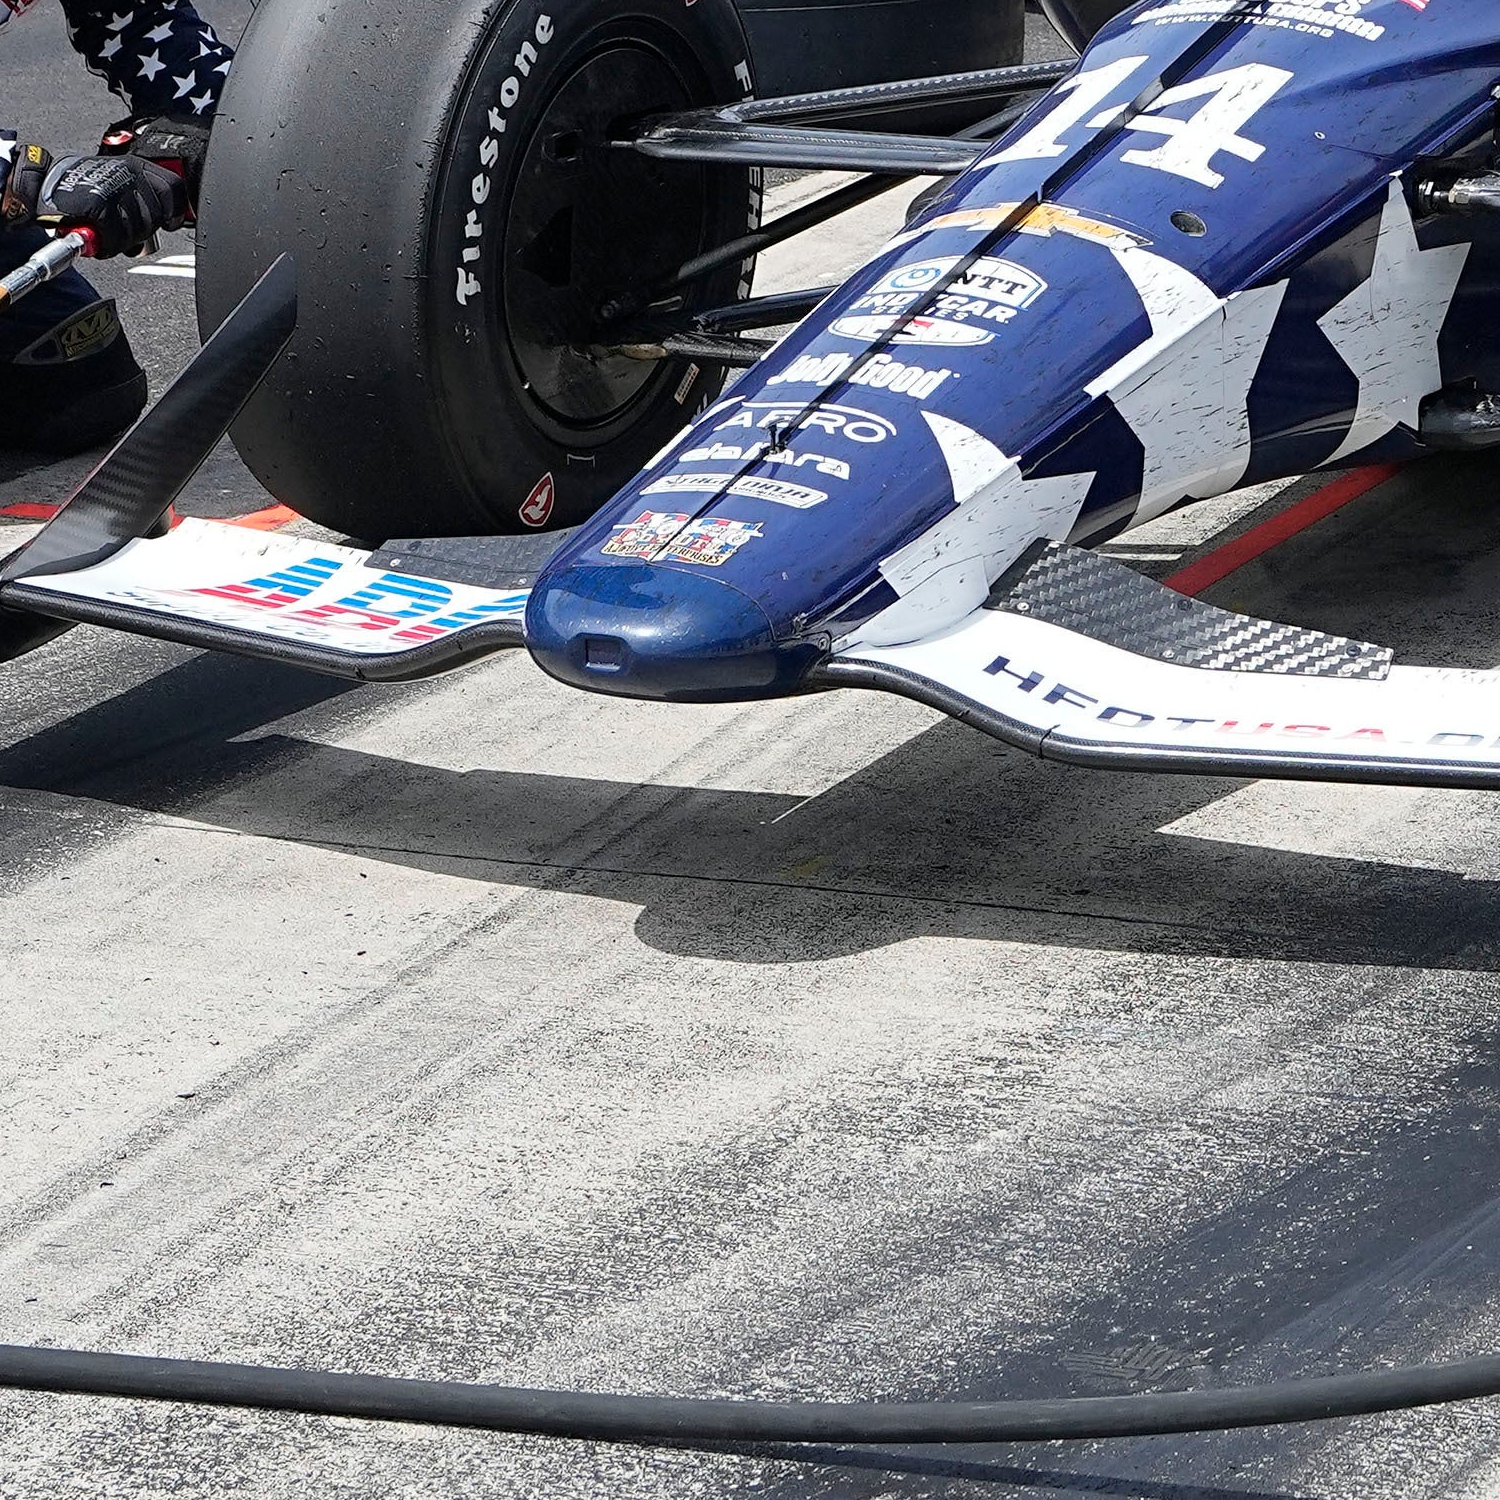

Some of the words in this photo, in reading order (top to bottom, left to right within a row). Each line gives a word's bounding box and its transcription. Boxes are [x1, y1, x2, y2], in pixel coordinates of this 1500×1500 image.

[971, 54, 1296, 190] 14
[456, 13, 556, 307] Firestone
[954, 271, 1028, 296] NTT
[871, 304, 970, 322] SEIES
[848, 352, 952, 401] Good
[713, 409, 888, 443] AERO
